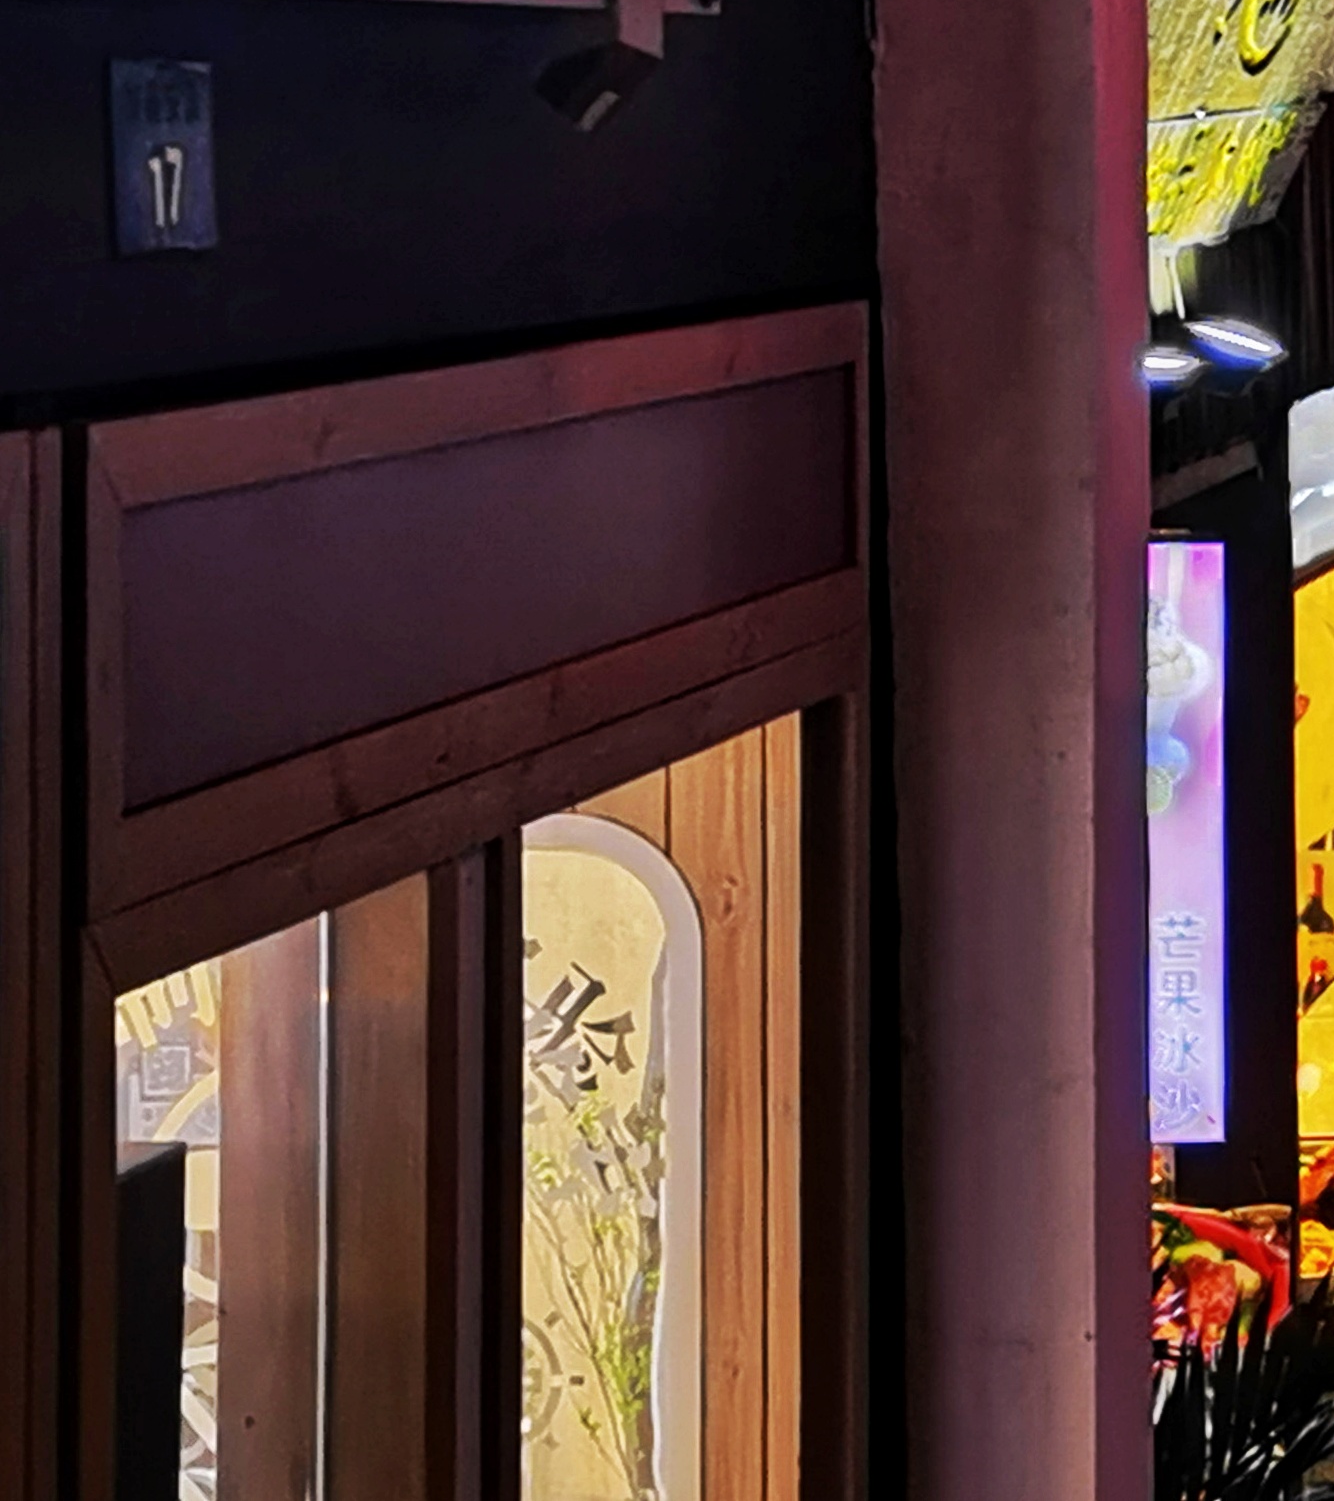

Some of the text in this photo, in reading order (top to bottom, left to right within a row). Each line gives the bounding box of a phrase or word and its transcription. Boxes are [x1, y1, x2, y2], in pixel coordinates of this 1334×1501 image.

[148, 146, 184, 228] 17
[1154, 913, 1203, 1132] 芒果冰沙
